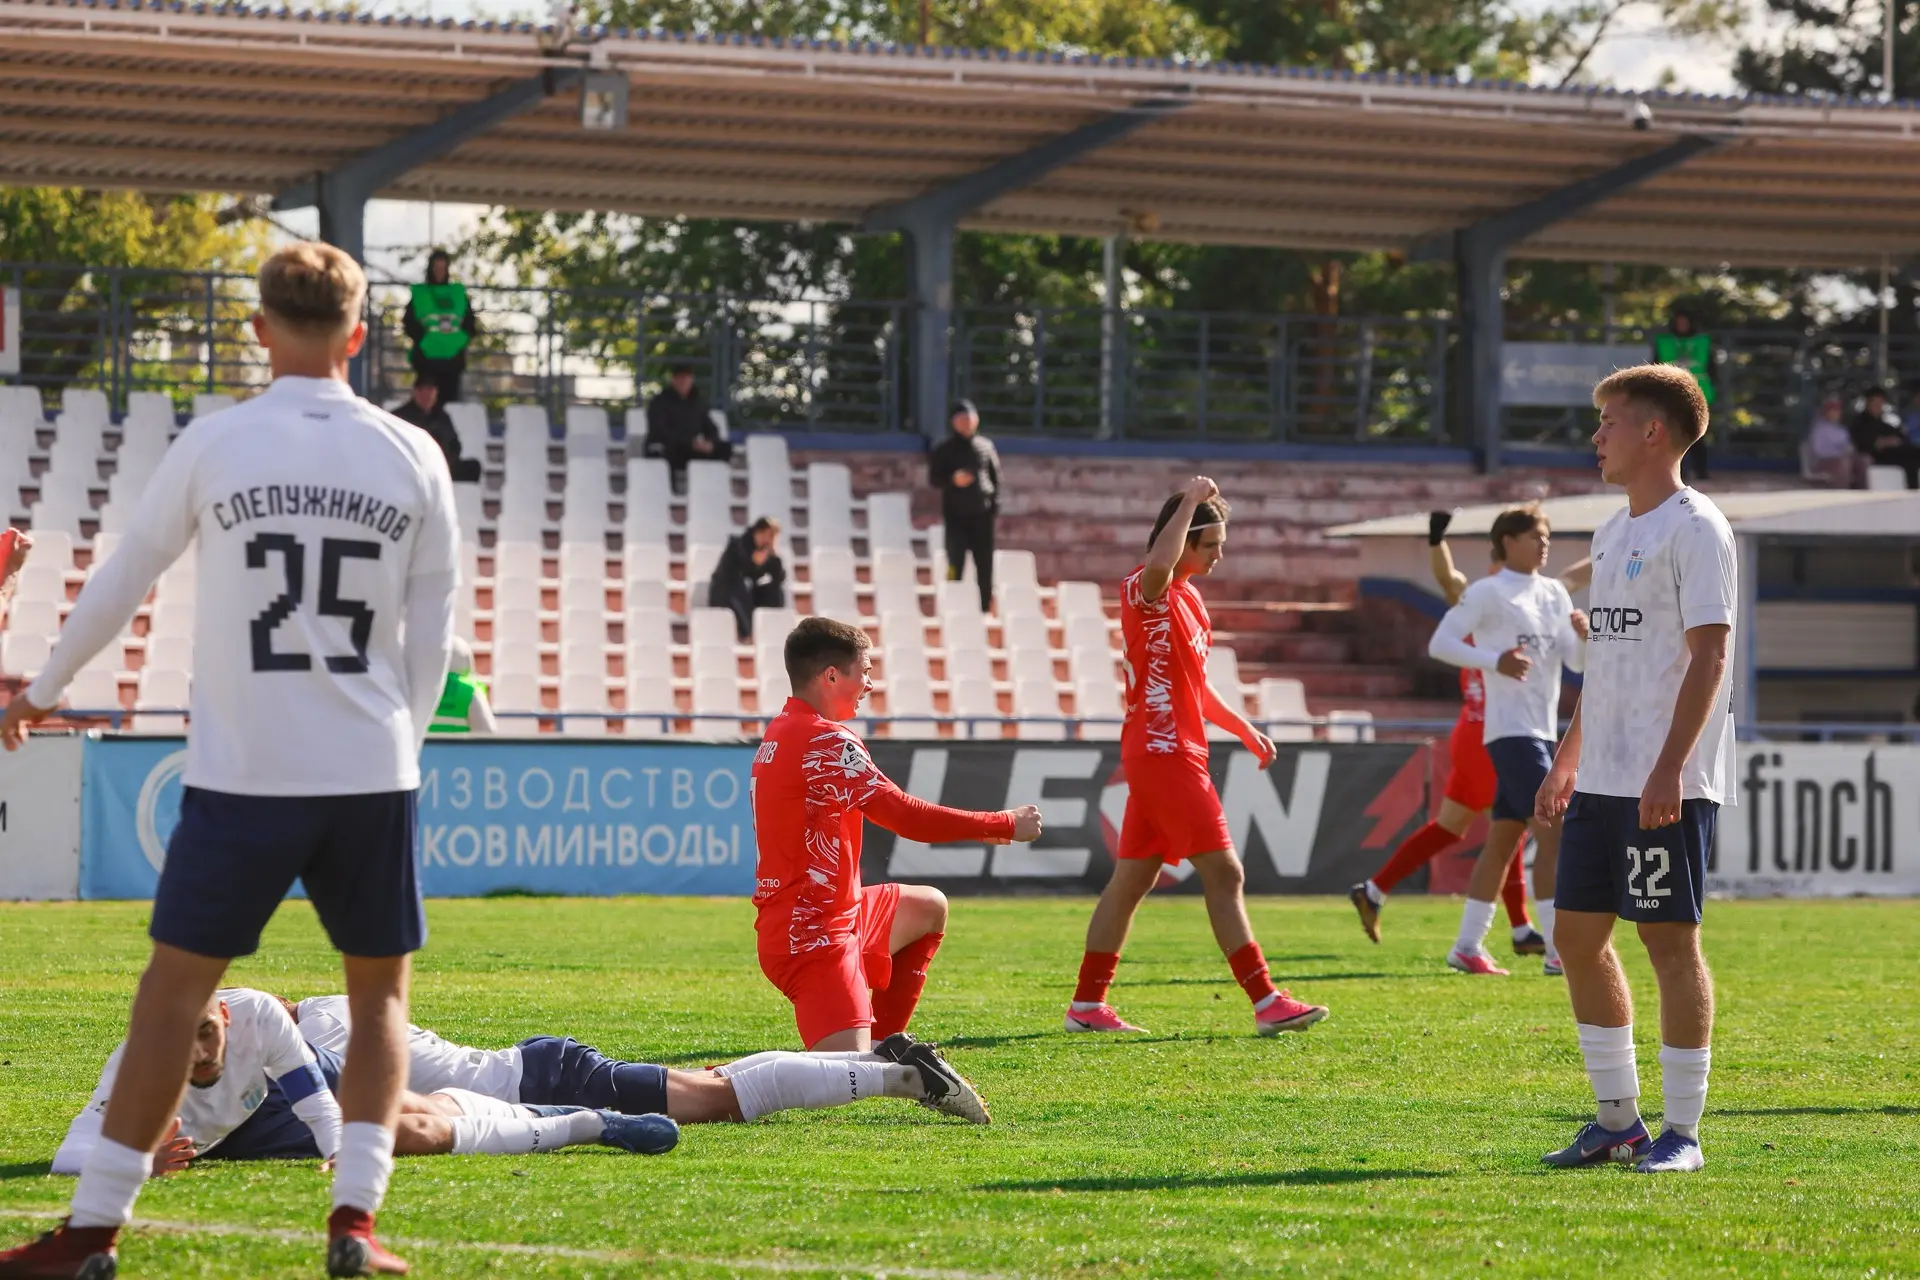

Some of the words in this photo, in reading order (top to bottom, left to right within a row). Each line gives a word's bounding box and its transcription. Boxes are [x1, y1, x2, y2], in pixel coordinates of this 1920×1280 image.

[213, 485, 412, 543] СЛЕПУЖНИКОВ
[245, 532, 382, 674] 25
[418, 767, 739, 812] ИЗВОДСТВО
[1742, 750, 1893, 873] finch
[422, 824, 508, 867] КОВ
[1626, 846, 1671, 897] 22
